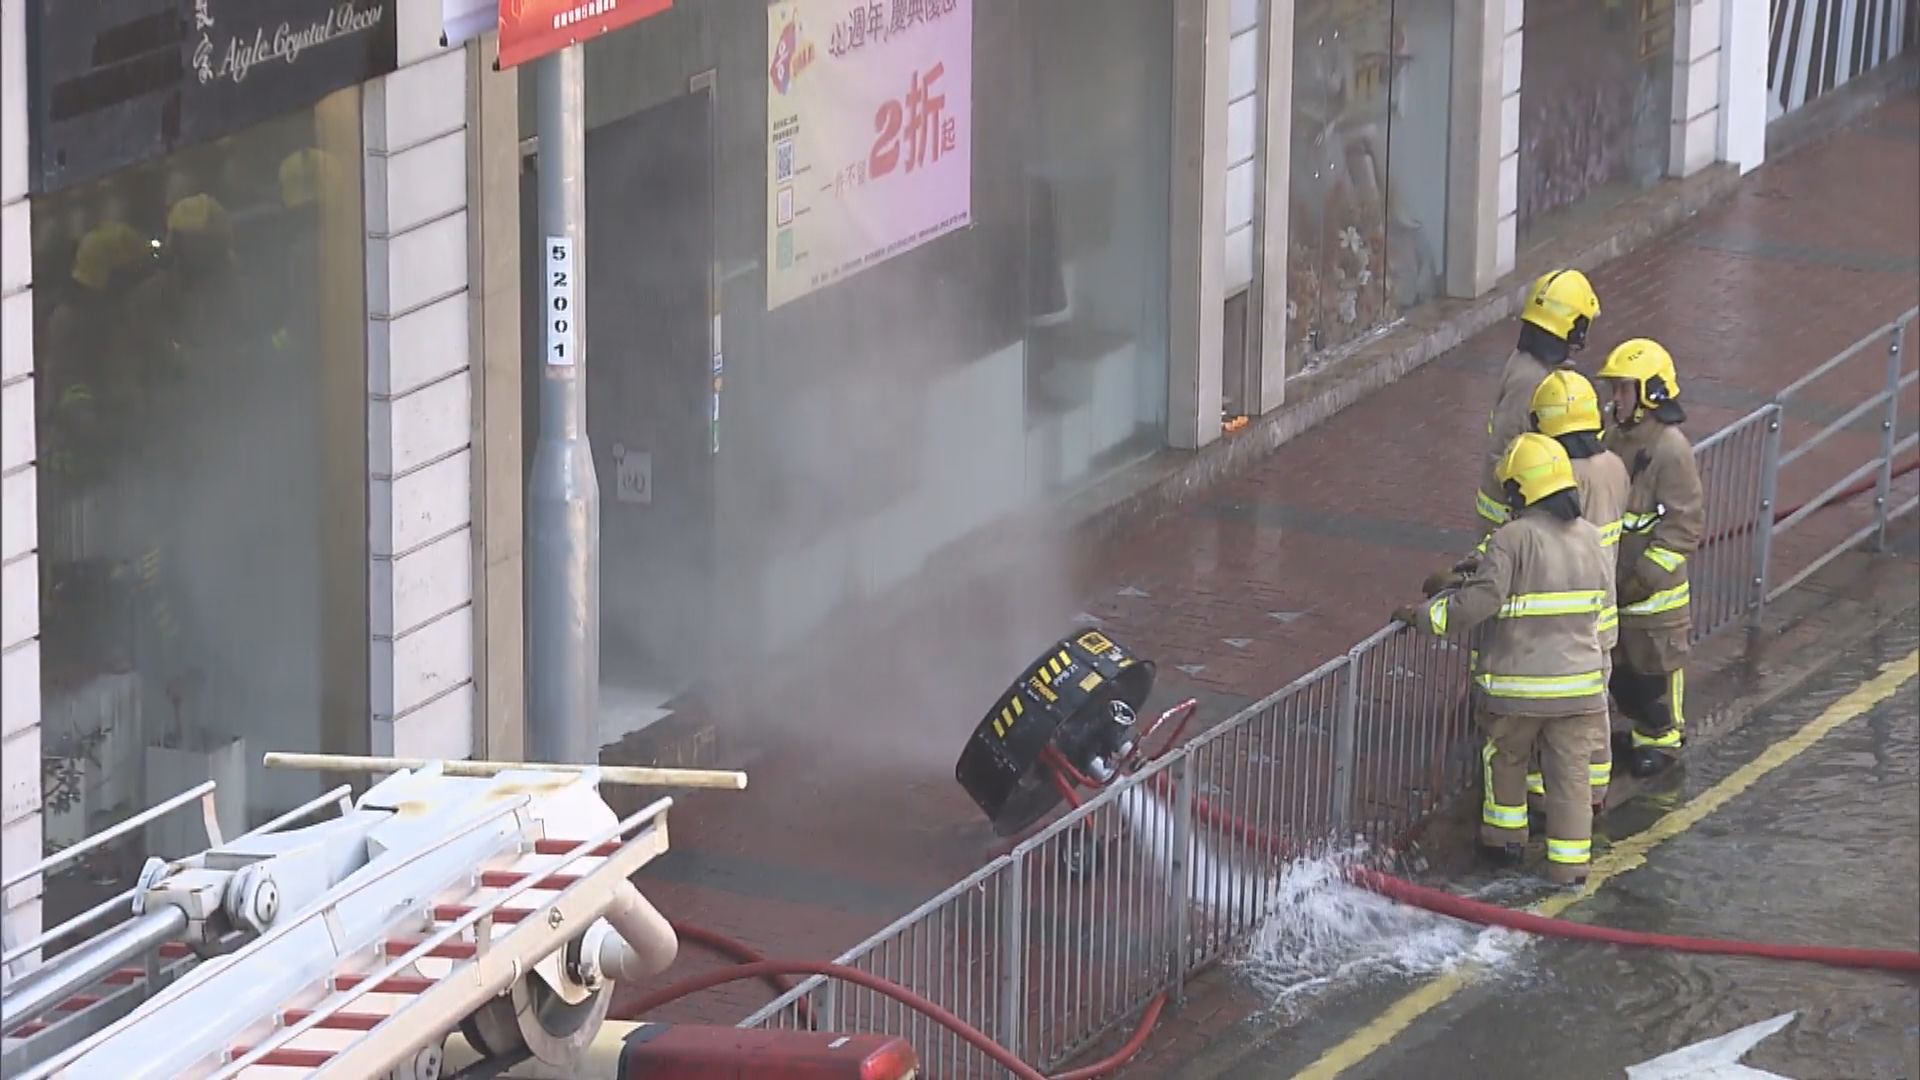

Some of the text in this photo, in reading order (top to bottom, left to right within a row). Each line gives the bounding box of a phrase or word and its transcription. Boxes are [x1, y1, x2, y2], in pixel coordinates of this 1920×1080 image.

[217, 2, 382, 83] Aigle Crystal Decor
[868, 61, 956, 180] 2折起
[552, 245, 568, 358] 52001
